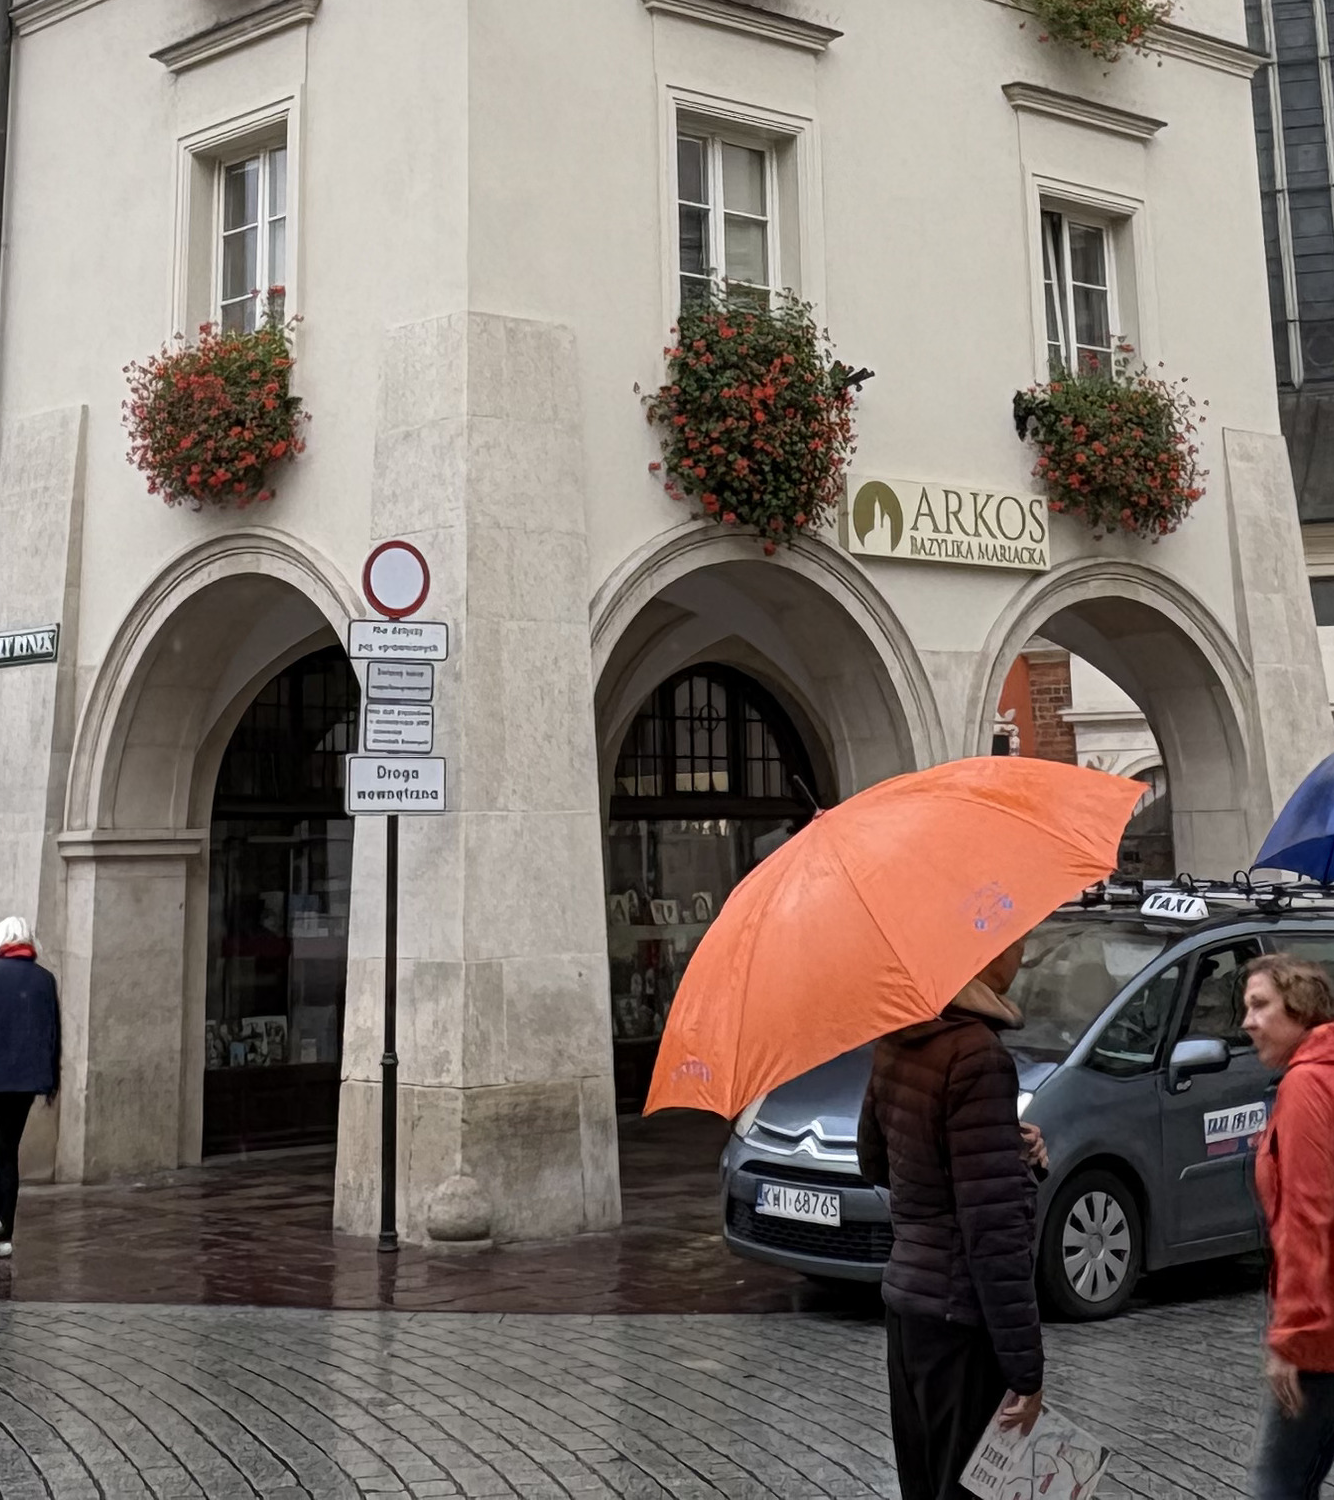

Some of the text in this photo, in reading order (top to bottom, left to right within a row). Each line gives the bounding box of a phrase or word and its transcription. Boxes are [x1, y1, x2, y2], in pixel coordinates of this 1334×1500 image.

[910, 486, 1045, 543] ARKOS
[910, 535, 1046, 566] BAZYLIKA MARIACKA
[376, 764, 420, 783] Droga
[1149, 895, 1196, 914] TAXI
[794, 1192, 837, 1217] 68765
